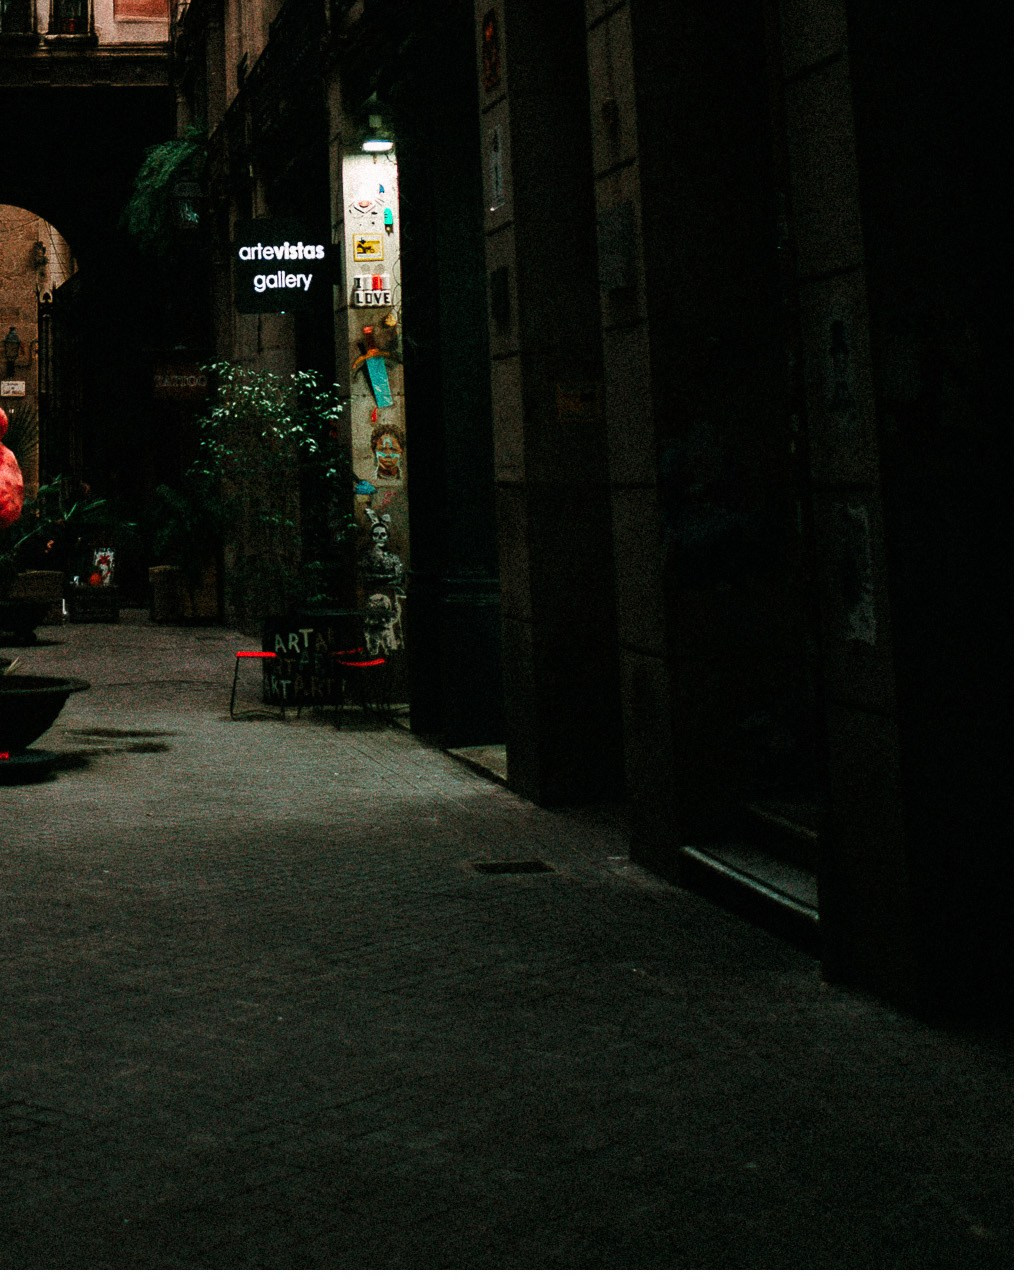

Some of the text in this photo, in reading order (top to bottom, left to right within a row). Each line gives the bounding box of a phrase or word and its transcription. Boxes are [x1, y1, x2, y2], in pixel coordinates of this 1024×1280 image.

[239, 241, 325, 261] artevistas
[254, 271, 313, 293] gallery
[355, 292, 391, 305] LOVE
